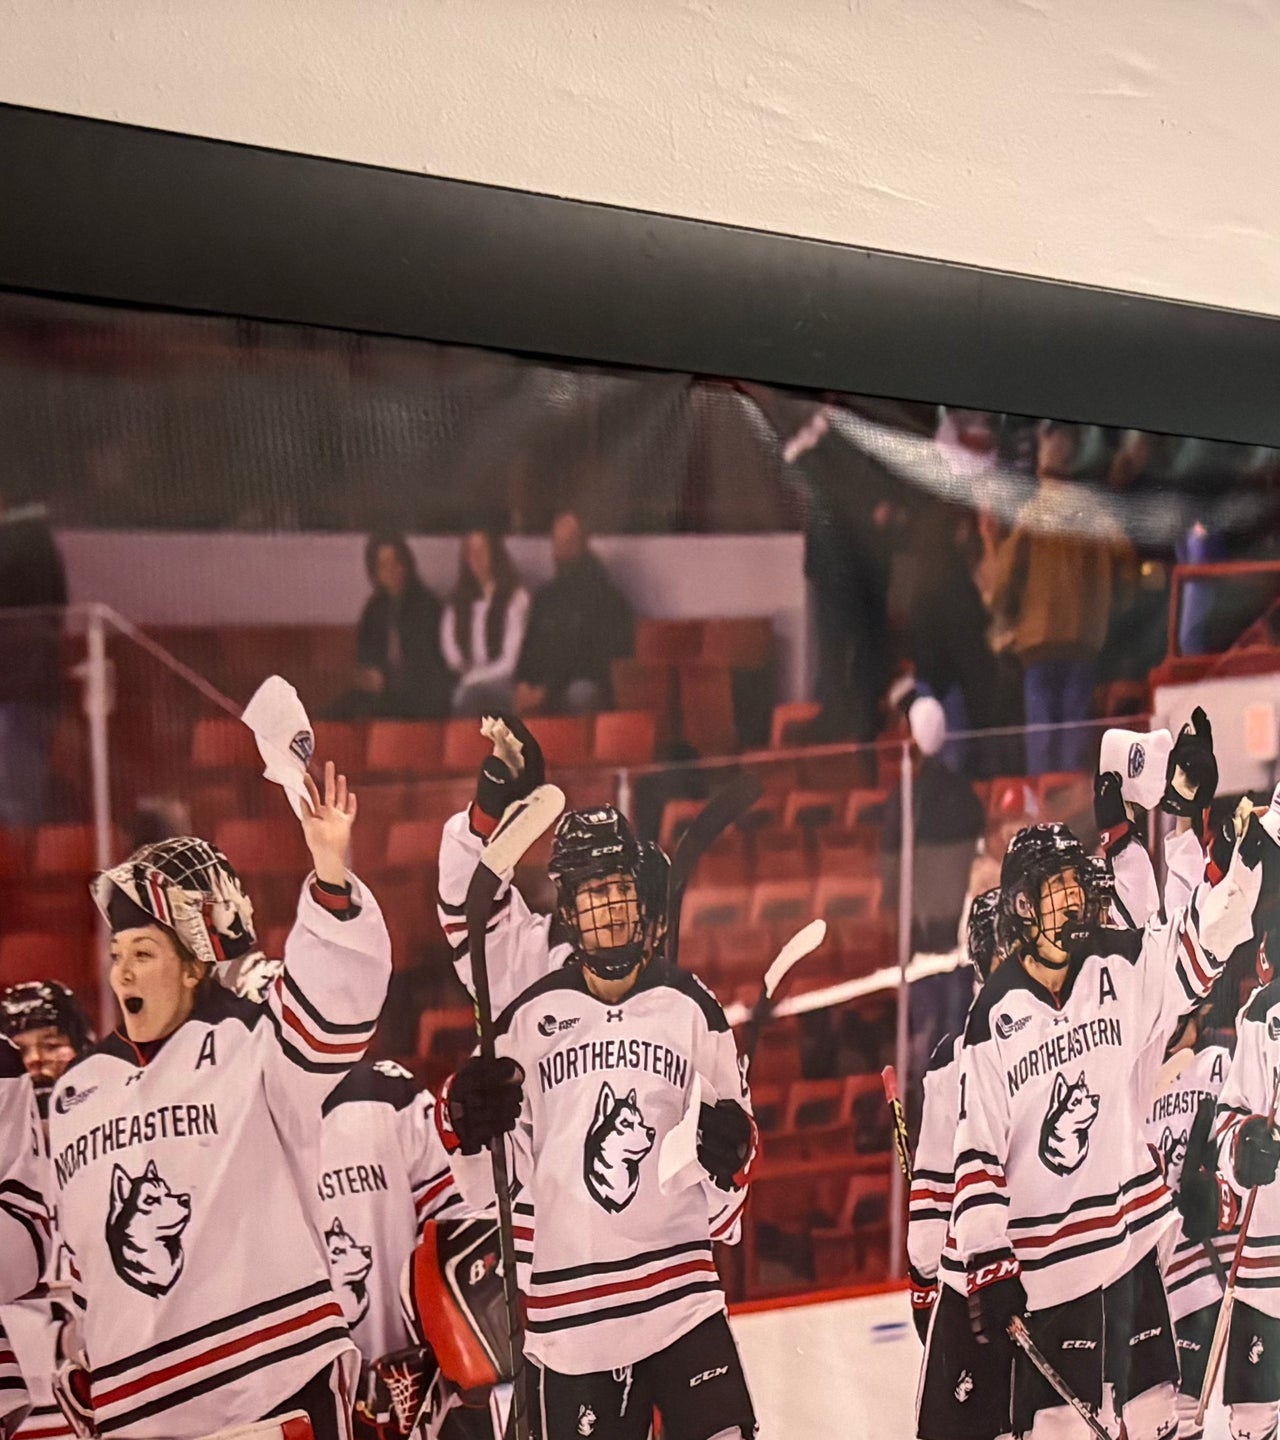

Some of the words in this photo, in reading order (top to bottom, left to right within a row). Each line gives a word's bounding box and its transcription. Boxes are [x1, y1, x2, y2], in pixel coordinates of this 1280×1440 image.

[1099, 966, 1117, 1005] A
[195, 1030, 216, 1070] A
[538, 1039, 688, 1094] NORTHEASTERN
[1006, 1018, 1122, 1098] NORTHEASTERN
[1210, 1054, 1223, 1083] A
[54, 1103, 219, 1191] NORTHEASTERN
[1062, 1340, 1097, 1350] CCM
[1129, 1327, 1162, 1346] CCM
[689, 1365, 729, 1387] CCM
